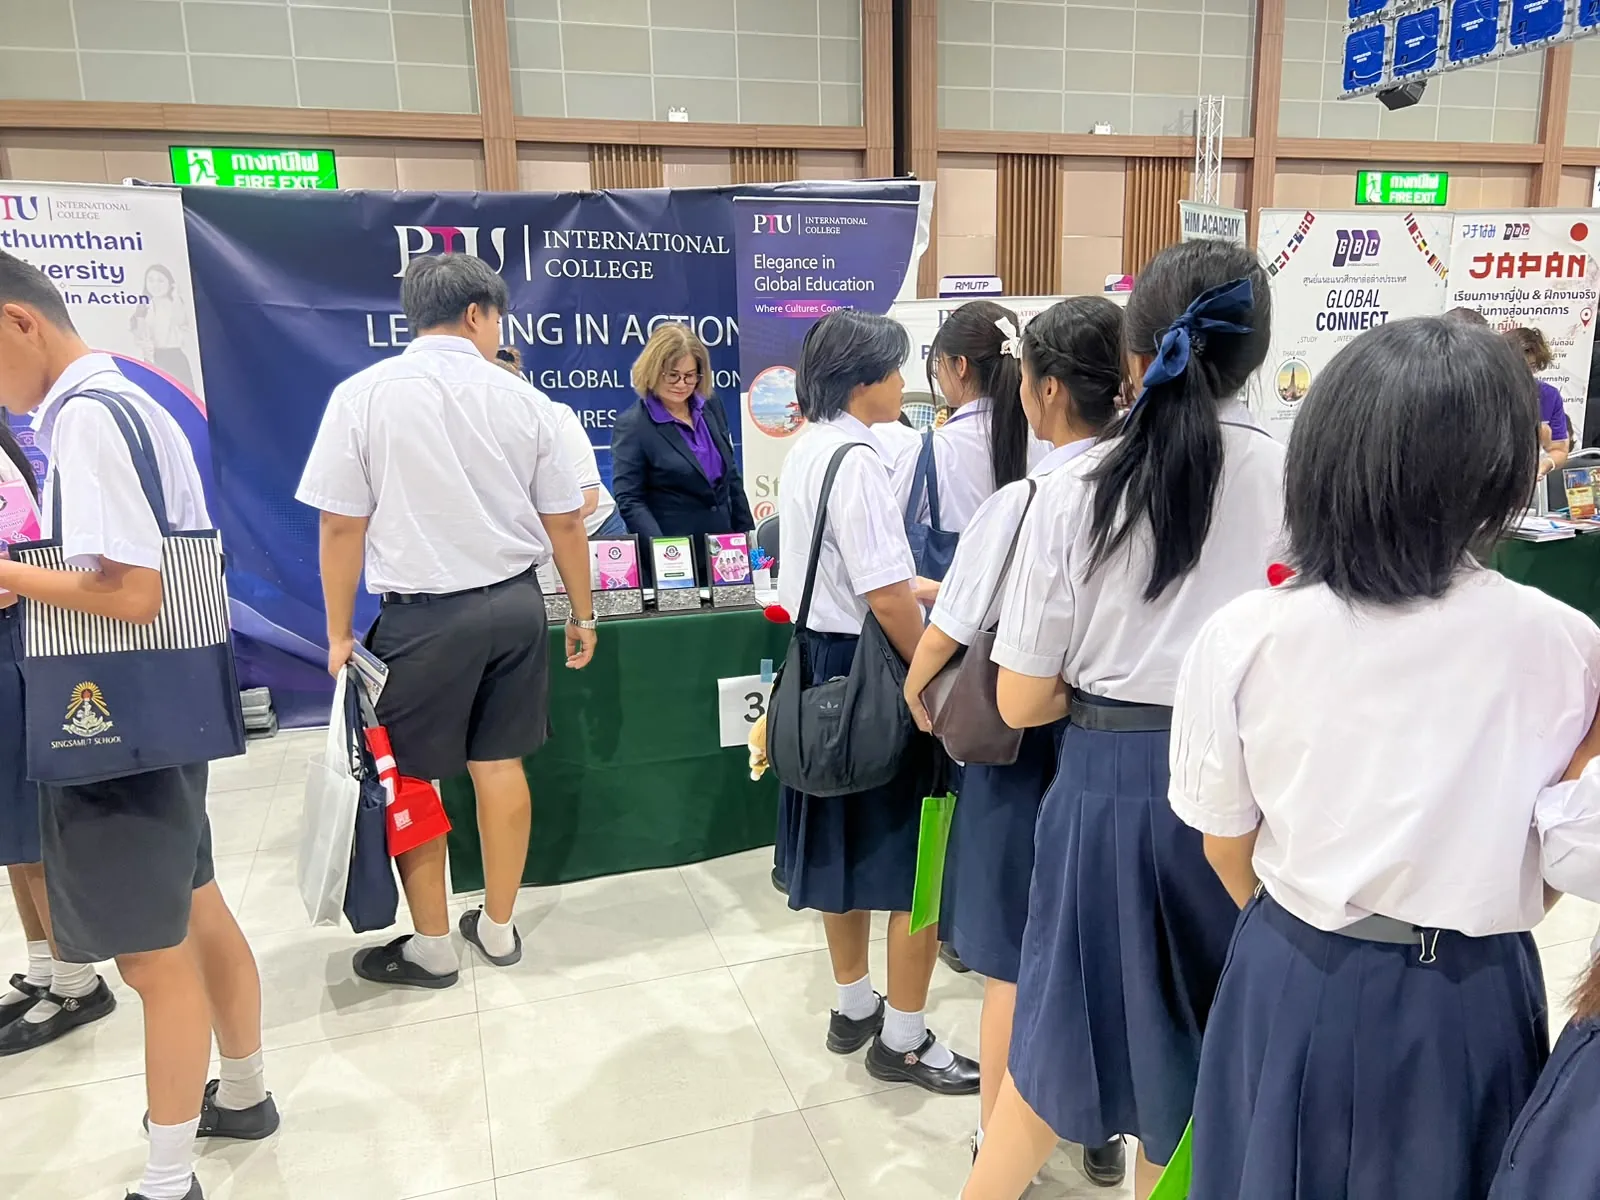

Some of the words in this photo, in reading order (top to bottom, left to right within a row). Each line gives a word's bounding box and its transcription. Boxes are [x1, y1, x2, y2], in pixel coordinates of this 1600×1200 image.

[231, 151, 320, 172] ทางหนีไฟ
[234, 175, 276, 189] FIRE
[279, 176, 321, 190] EXIT
[56, 200, 131, 211] INTERNATIONAL
[1390, 191, 1413, 204] FIRE
[1414, 191, 1437, 204] EXIT
[57, 211, 101, 220] COLLEGE
[752, 214, 792, 235] PTU
[805, 216, 868, 225] INTERNATIONAL
[1184, 211, 1200, 233] HIM
[1201, 214, 1241, 237] ACADEMY
[805, 226, 841, 235] COLLEGE
[543, 230, 730, 254] INTERNATIONAL
[544, 258, 654, 280] COLLEGE
[754, 253, 819, 273] Elegance
[822, 254, 836, 270] in
[1469, 251, 1586, 279] JAPAN
[754, 276, 801, 292] Global
[805, 276, 875, 292] Education
[954, 281, 989, 291] RMUTP
[65, 291, 82, 304] In
[88, 291, 150, 305] Action
[1326, 289, 1381, 309] GLOBAL
[1532, 289, 1541, 300] &
[755, 304, 783, 313] Where
[785, 304, 819, 313] Cultures
[576, 315, 605, 346] IN
[1315, 311, 1389, 332] CONNECT
[540, 369, 625, 389] GLOBAL
